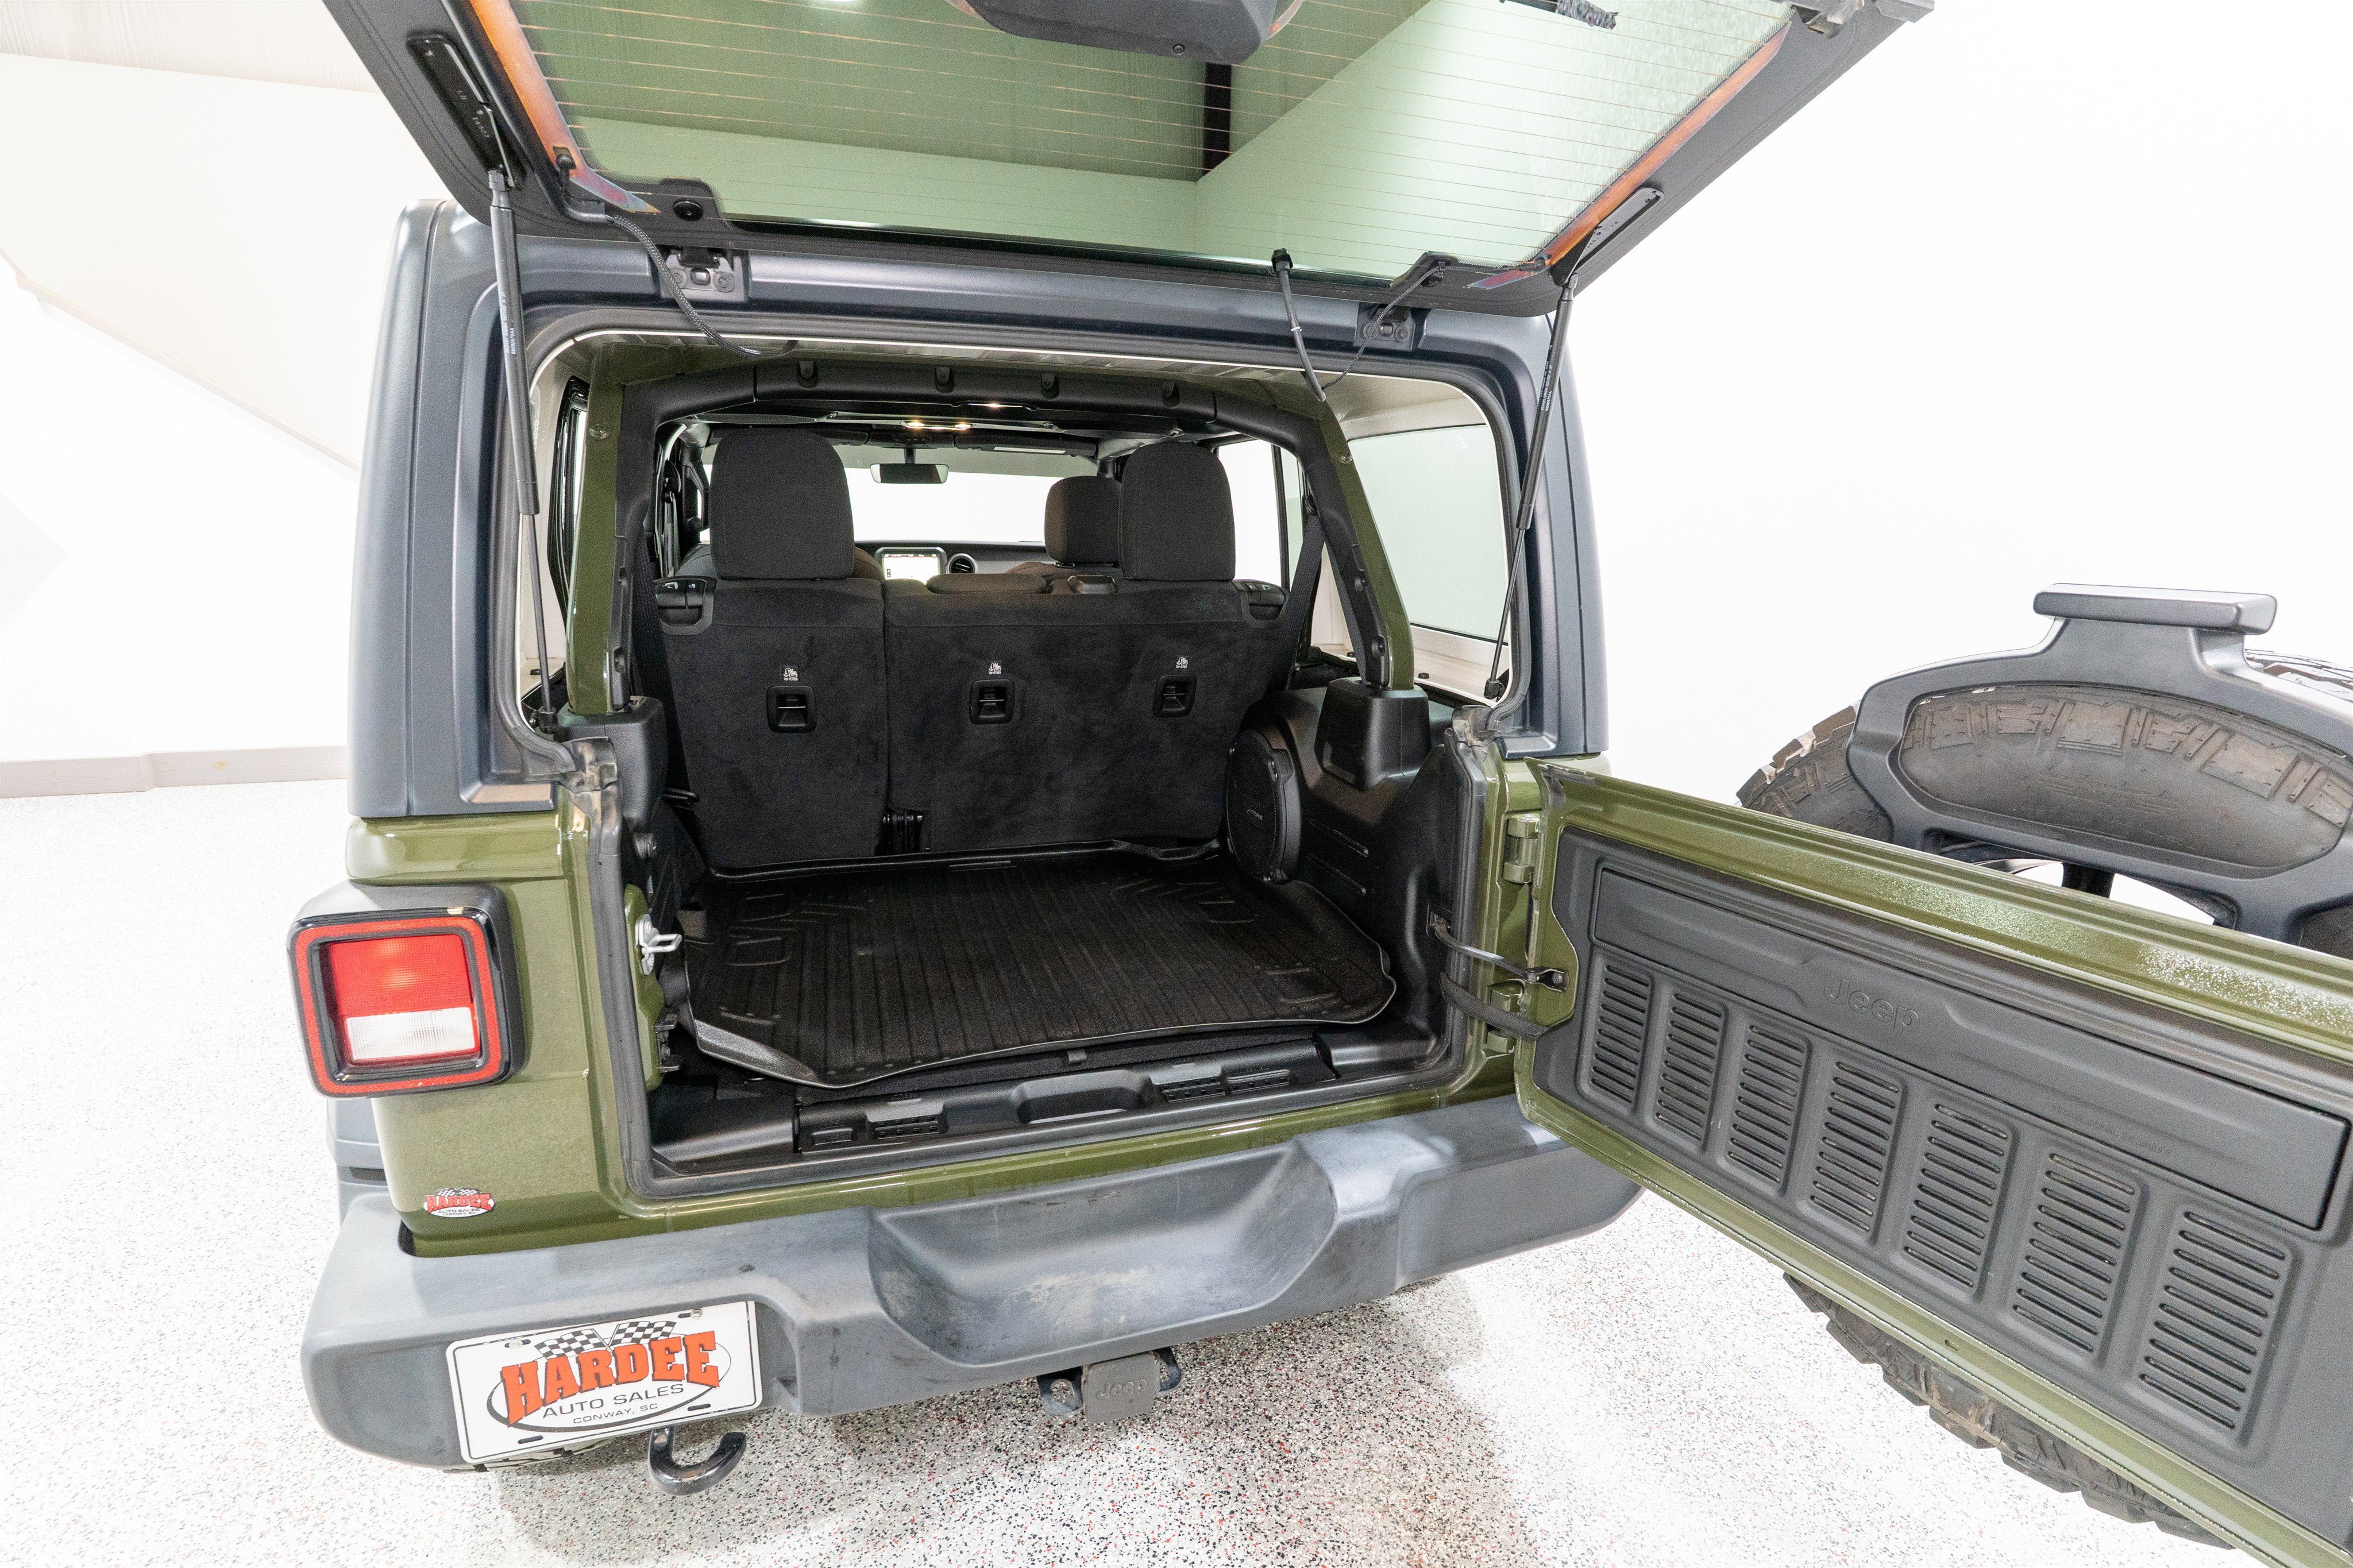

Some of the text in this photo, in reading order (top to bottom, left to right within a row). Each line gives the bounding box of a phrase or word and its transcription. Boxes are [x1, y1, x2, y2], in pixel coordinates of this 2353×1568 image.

[1823, 978, 1920, 1033] Jeep
[426, 1193, 492, 1214] HARDEE
[500, 1330, 720, 1428] HARDEE
[1096, 1378, 1148, 1401] Jeep
[542, 1382, 685, 1419] AUTO SALES
[572, 1402, 658, 1424] CONWAY, SC
